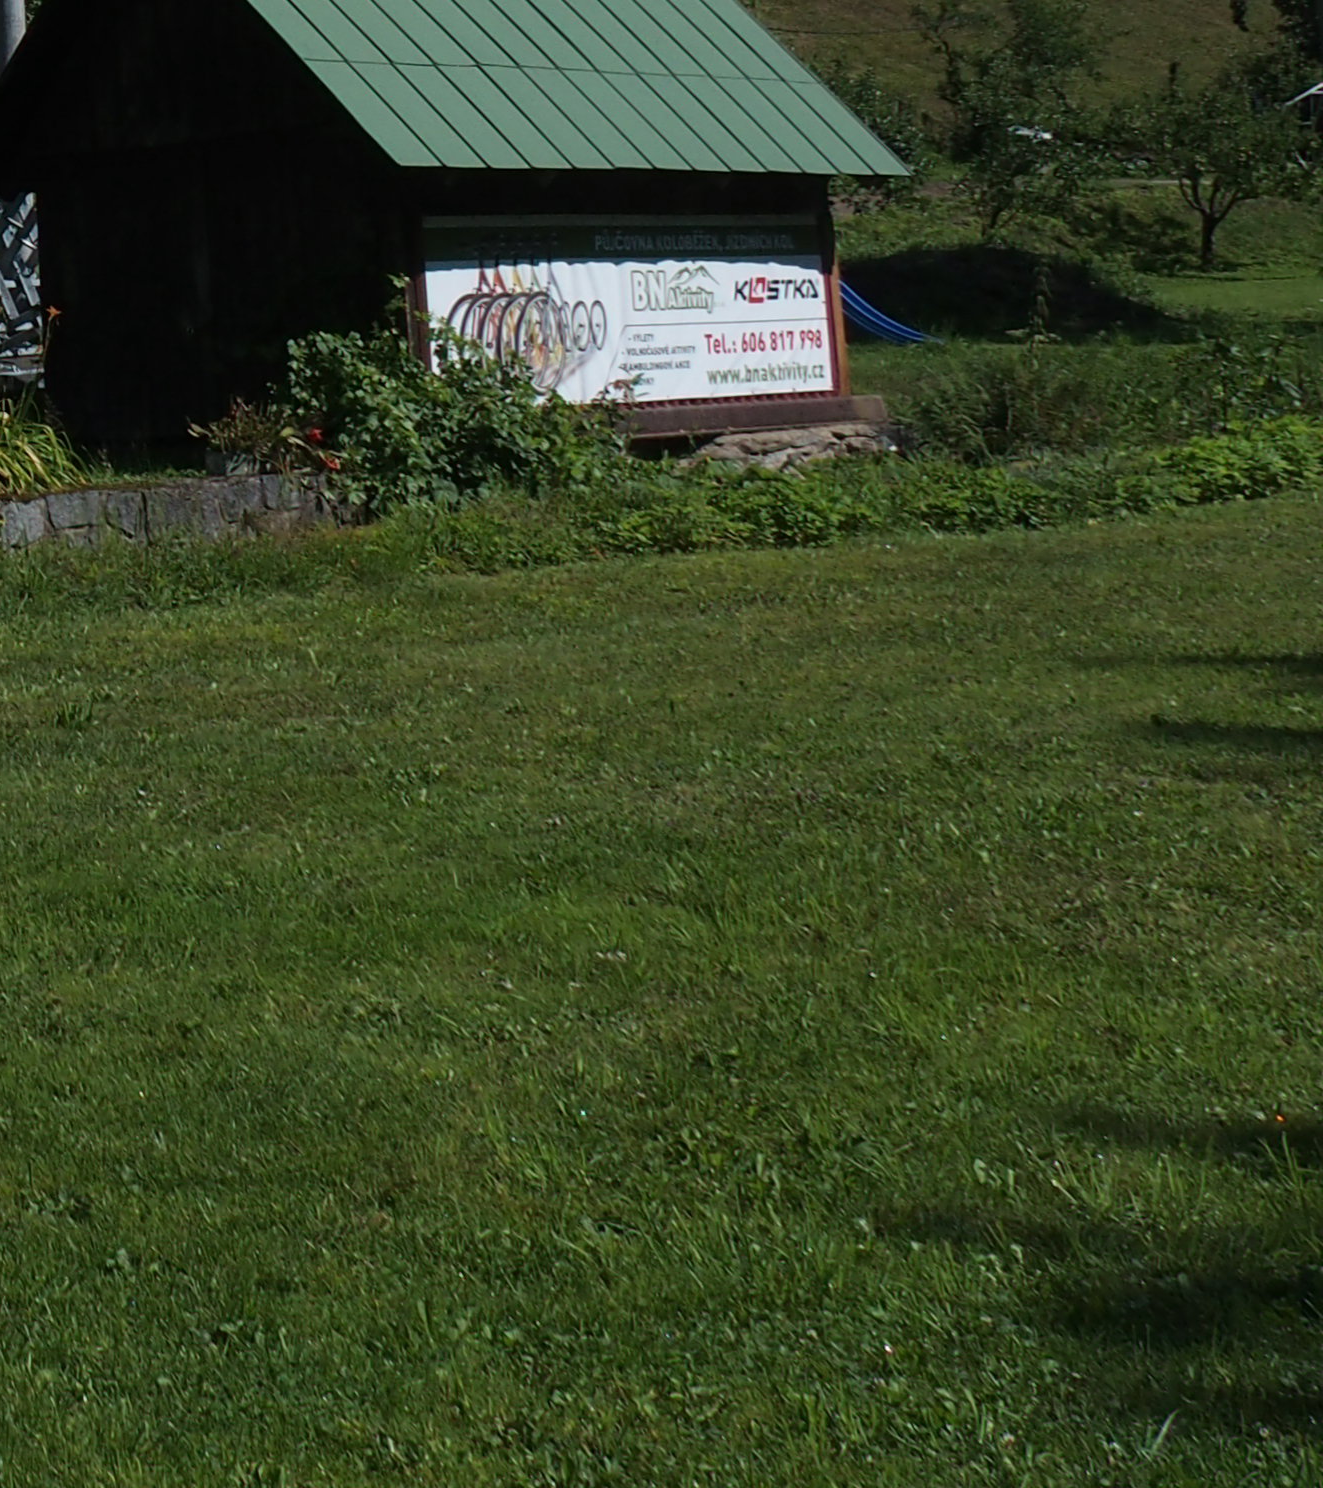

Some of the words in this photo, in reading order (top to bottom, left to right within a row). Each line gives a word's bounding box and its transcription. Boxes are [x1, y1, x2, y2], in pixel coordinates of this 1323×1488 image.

[630, 269, 667, 312] BN
[734, 277, 819, 303] KOSTKA
[704, 333, 737, 355] Tel.:
[741, 332, 766, 353] 606
[770, 331, 794, 351] 817
[799, 329, 823, 349] 998
[706, 364, 825, 385] www.bnaktivity.cz
